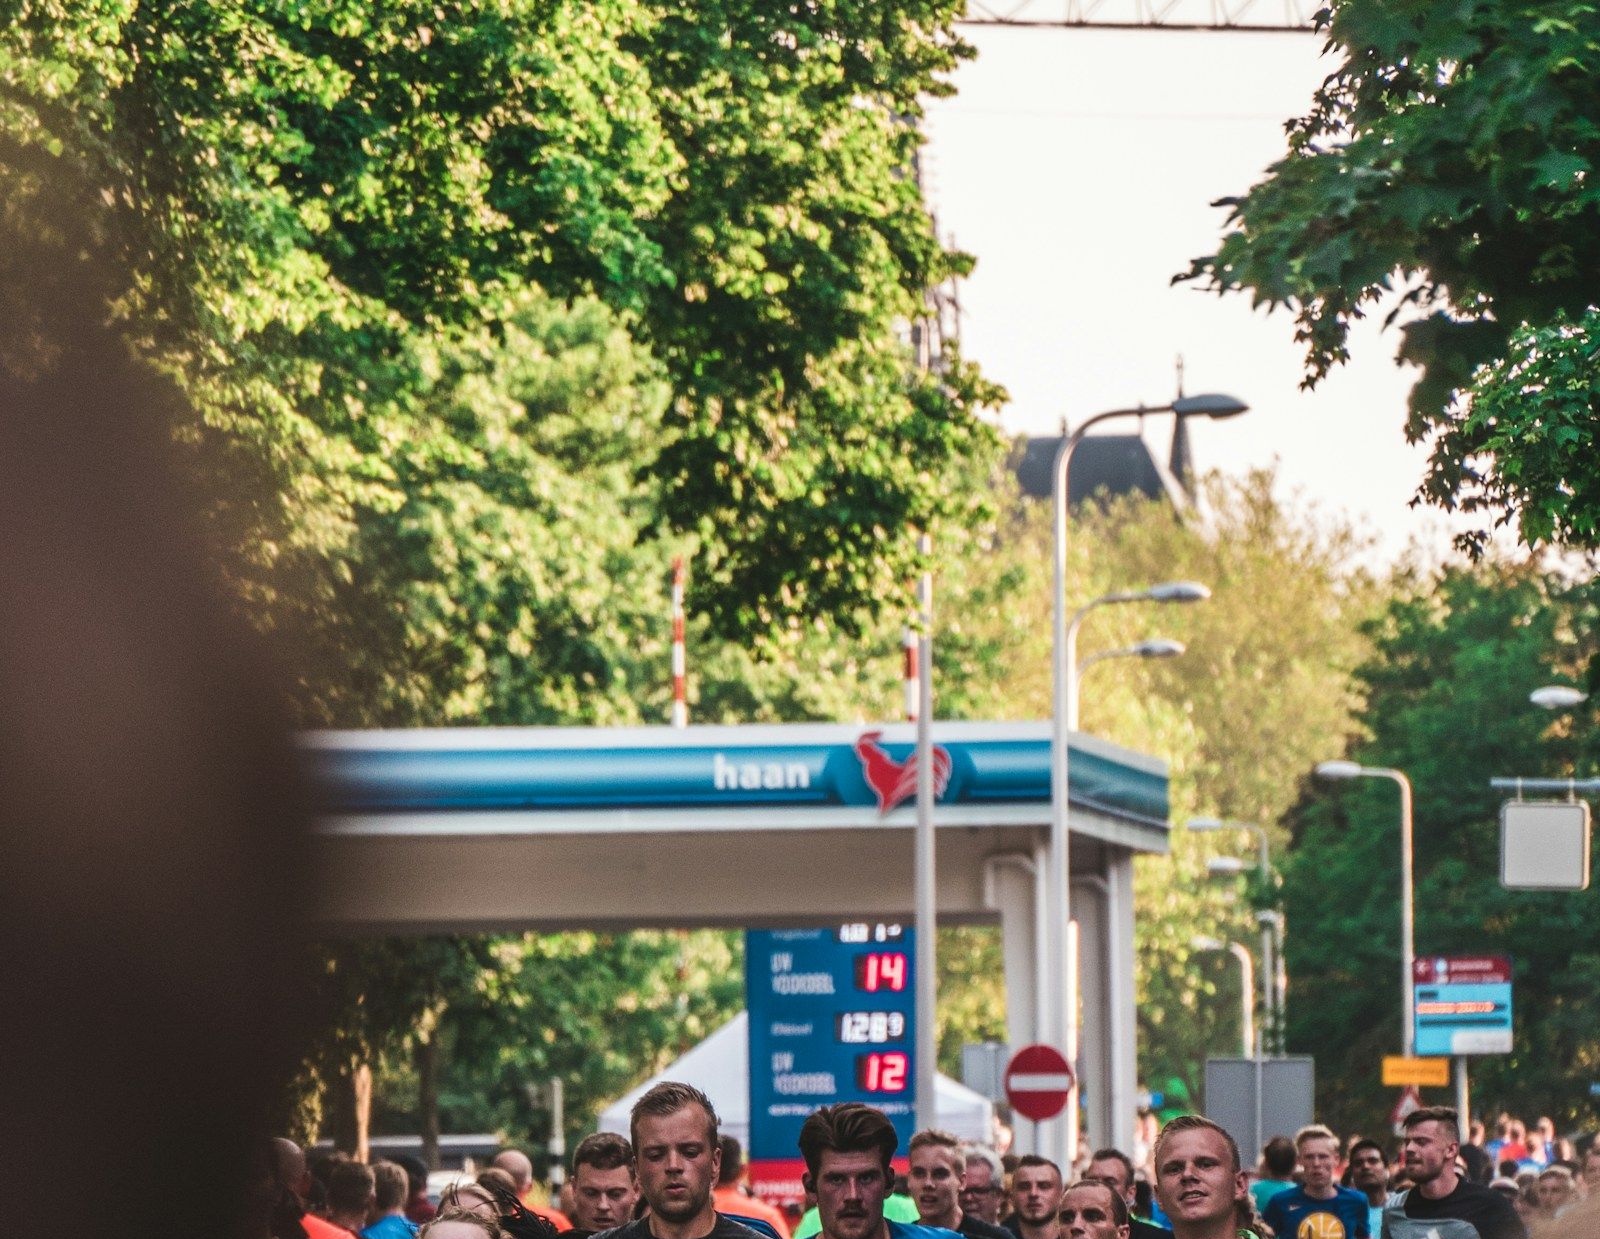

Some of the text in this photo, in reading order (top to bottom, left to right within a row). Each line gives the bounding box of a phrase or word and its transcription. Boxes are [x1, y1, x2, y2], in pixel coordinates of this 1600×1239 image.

[714, 753, 809, 790] haan
[865, 953, 907, 992] 14
[866, 1052, 909, 1093] 12
